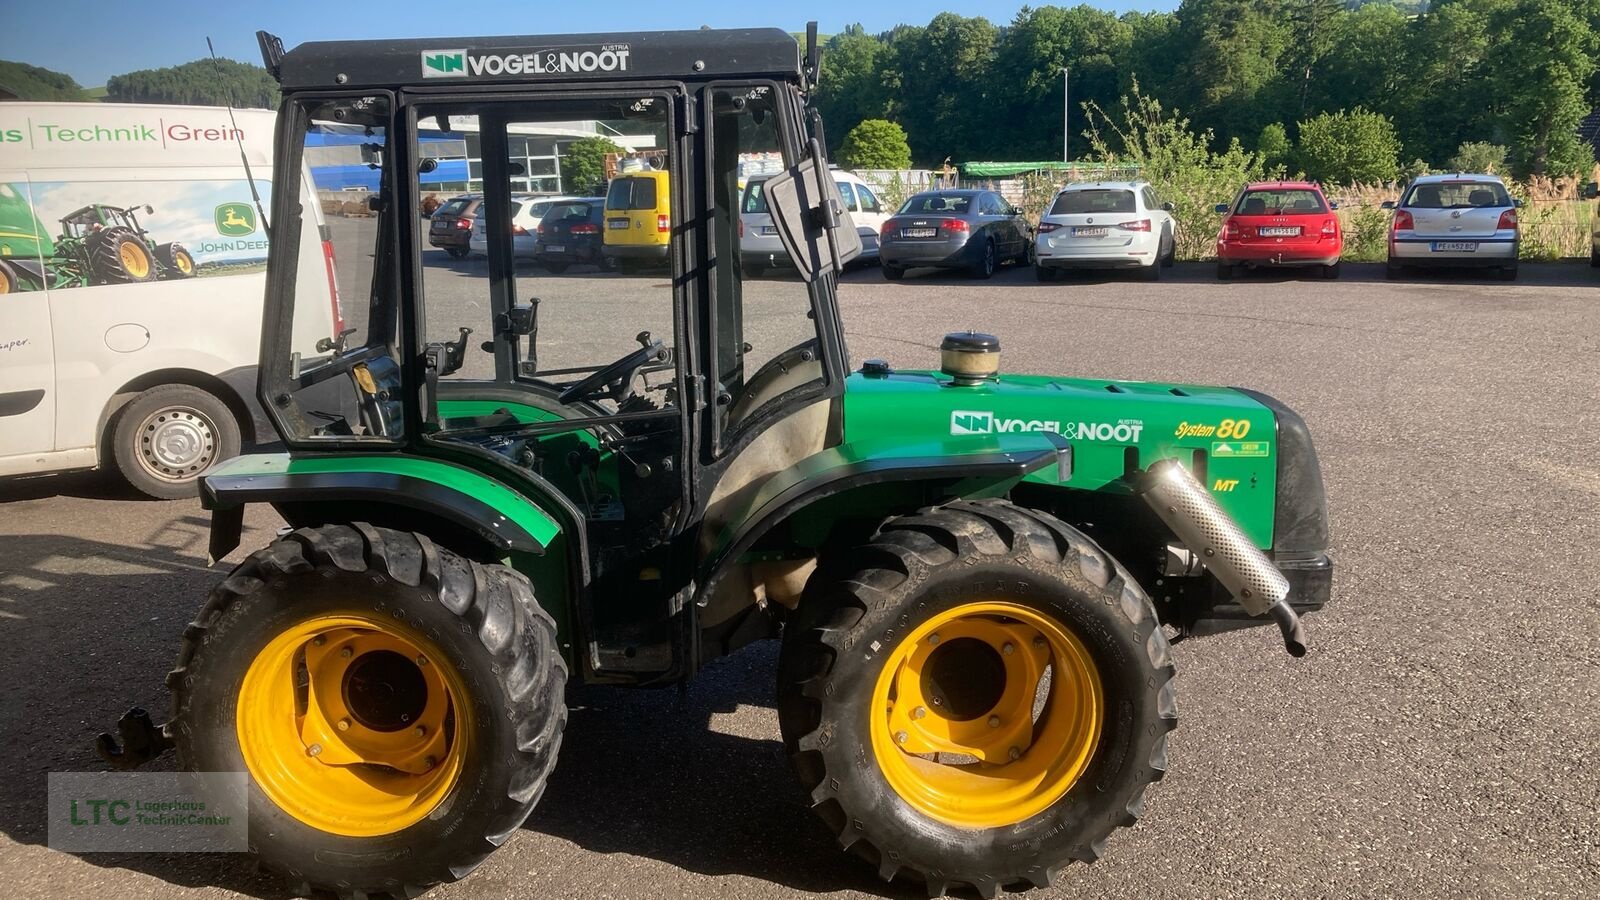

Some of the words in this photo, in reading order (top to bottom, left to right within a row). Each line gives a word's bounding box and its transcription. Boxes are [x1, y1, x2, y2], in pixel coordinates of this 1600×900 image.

[601, 44, 629, 52] AUSTRIA
[468, 50, 630, 76] VOGEL&NOOT
[0, 128, 24, 143] s
[38, 124, 158, 142] Technik
[167, 124, 245, 141] Grein
[196, 242, 235, 253] JOHN
[1174, 421, 1216, 439] System
[1216, 419, 1251, 439] 80
[1213, 479, 1240, 492] MT
